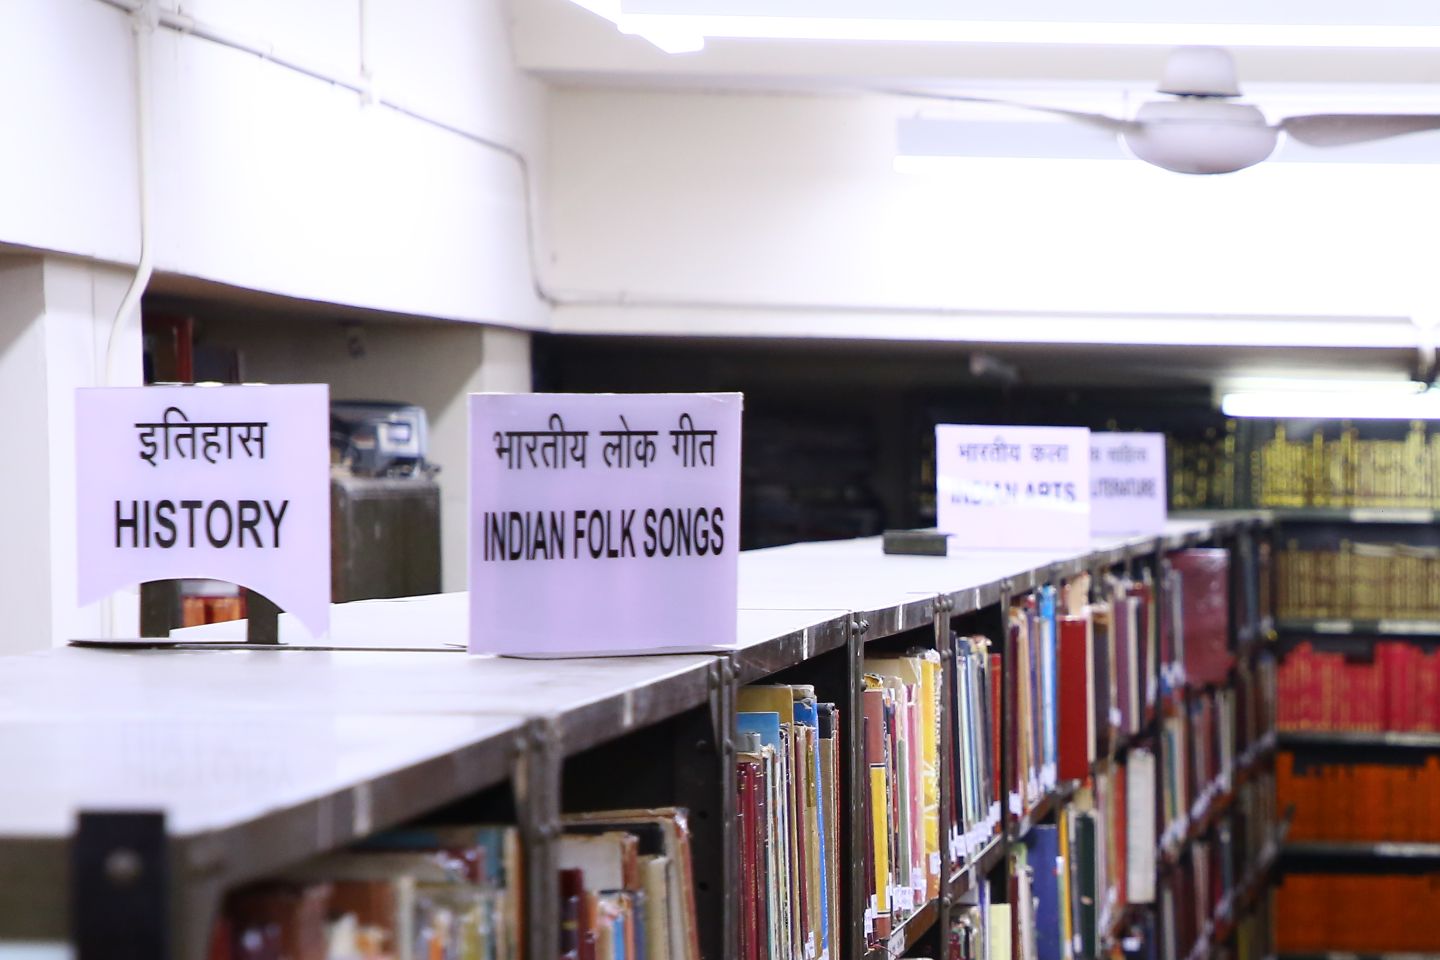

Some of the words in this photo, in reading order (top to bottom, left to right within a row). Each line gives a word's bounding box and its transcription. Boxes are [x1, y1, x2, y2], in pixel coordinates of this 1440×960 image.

[135, 406, 269, 468] इतिहास
[493, 412, 589, 470] भारतीय
[600, 414, 657, 469] लोक
[668, 412, 718, 468] गीत
[114, 499, 289, 549] HISTORY
[483, 510, 566, 562] INDIAN
[573, 508, 637, 560] FOLK
[643, 506, 725, 558] SONGS
